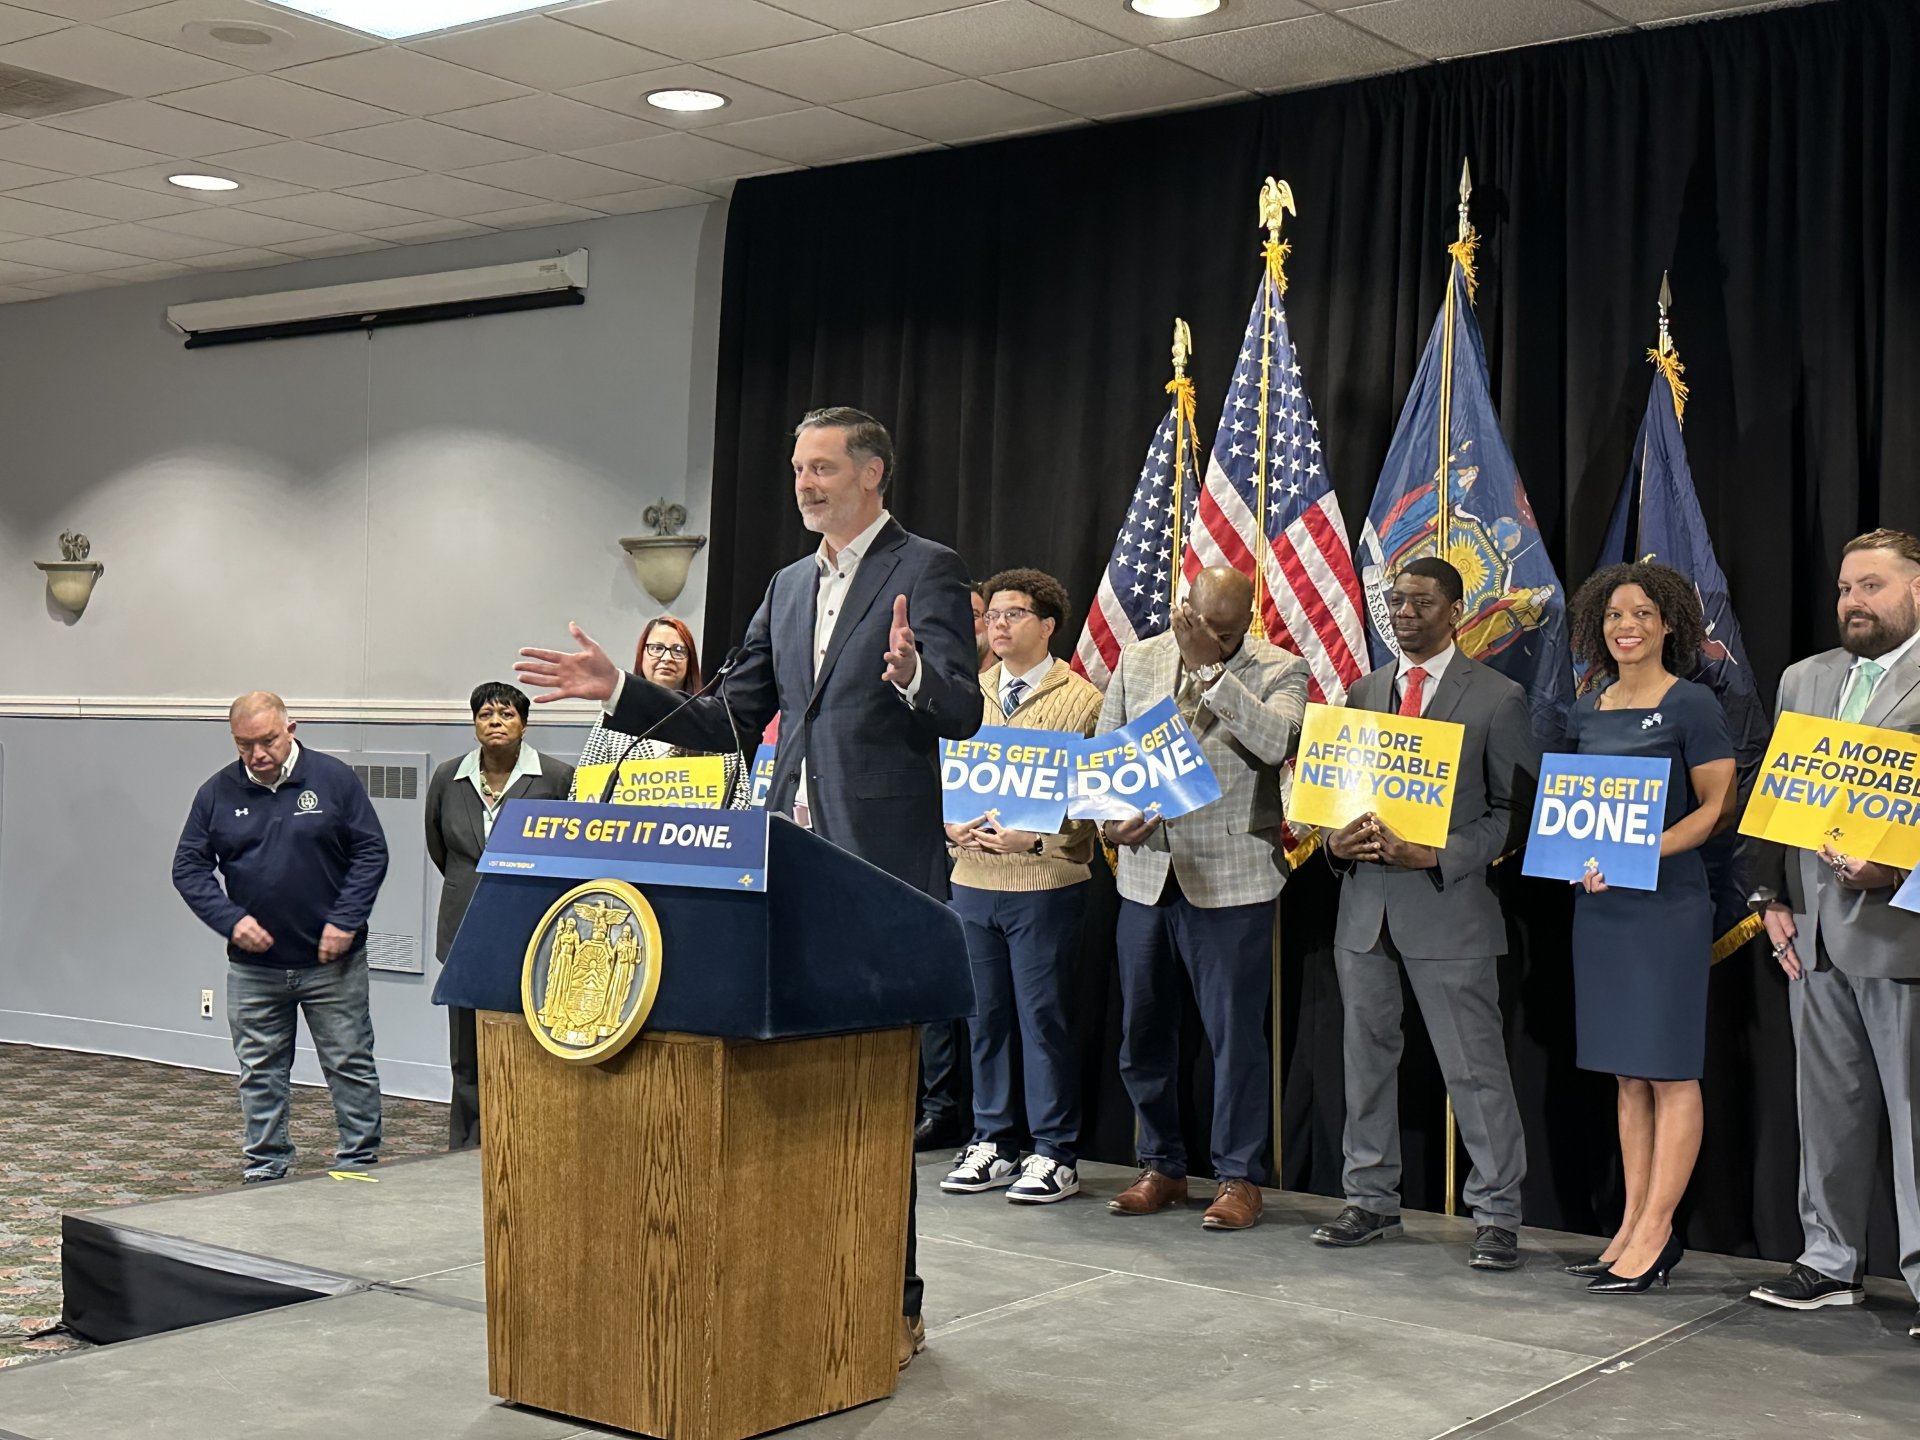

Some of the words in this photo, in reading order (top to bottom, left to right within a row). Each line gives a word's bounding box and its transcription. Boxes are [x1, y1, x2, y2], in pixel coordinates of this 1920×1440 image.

[1371, 583, 1395, 638] EXCELS
[945, 739, 1002, 761] LET'S
[1006, 745, 1050, 766] GET
[1053, 749, 1068, 768] IT
[1076, 741, 1138, 770] LET'S
[1141, 723, 1173, 754] GET
[1171, 713, 1185, 736] IT
[1336, 725, 1351, 743] A
[1358, 727, 1423, 753] MORE
[1812, 736, 1831, 756] A
[1838, 740, 1918, 772] MORE
[631, 770, 690, 786] MORE
[1076, 736, 1204, 797] DONE.
[1305, 741, 1451, 780] AFFORDABLE
[1771, 752, 1920, 798] AFFORDABL
[586, 785, 718, 803] AFORDABLE
[941, 758, 1065, 802] DONE.
[1300, 762, 1363, 791] NEW
[1369, 772, 1447, 808] YORK
[1543, 774, 1596, 798] LET'S
[1599, 777, 1640, 800] GET
[1643, 779, 1663, 802] IT
[1760, 773, 1840, 808] NEW
[522, 815, 580, 841] LET'S
[584, 820, 630, 843] GET
[632, 822, 657, 845] IT
[659, 823, 733, 849] DONE.
[1536, 797, 1656, 846] DONE.
